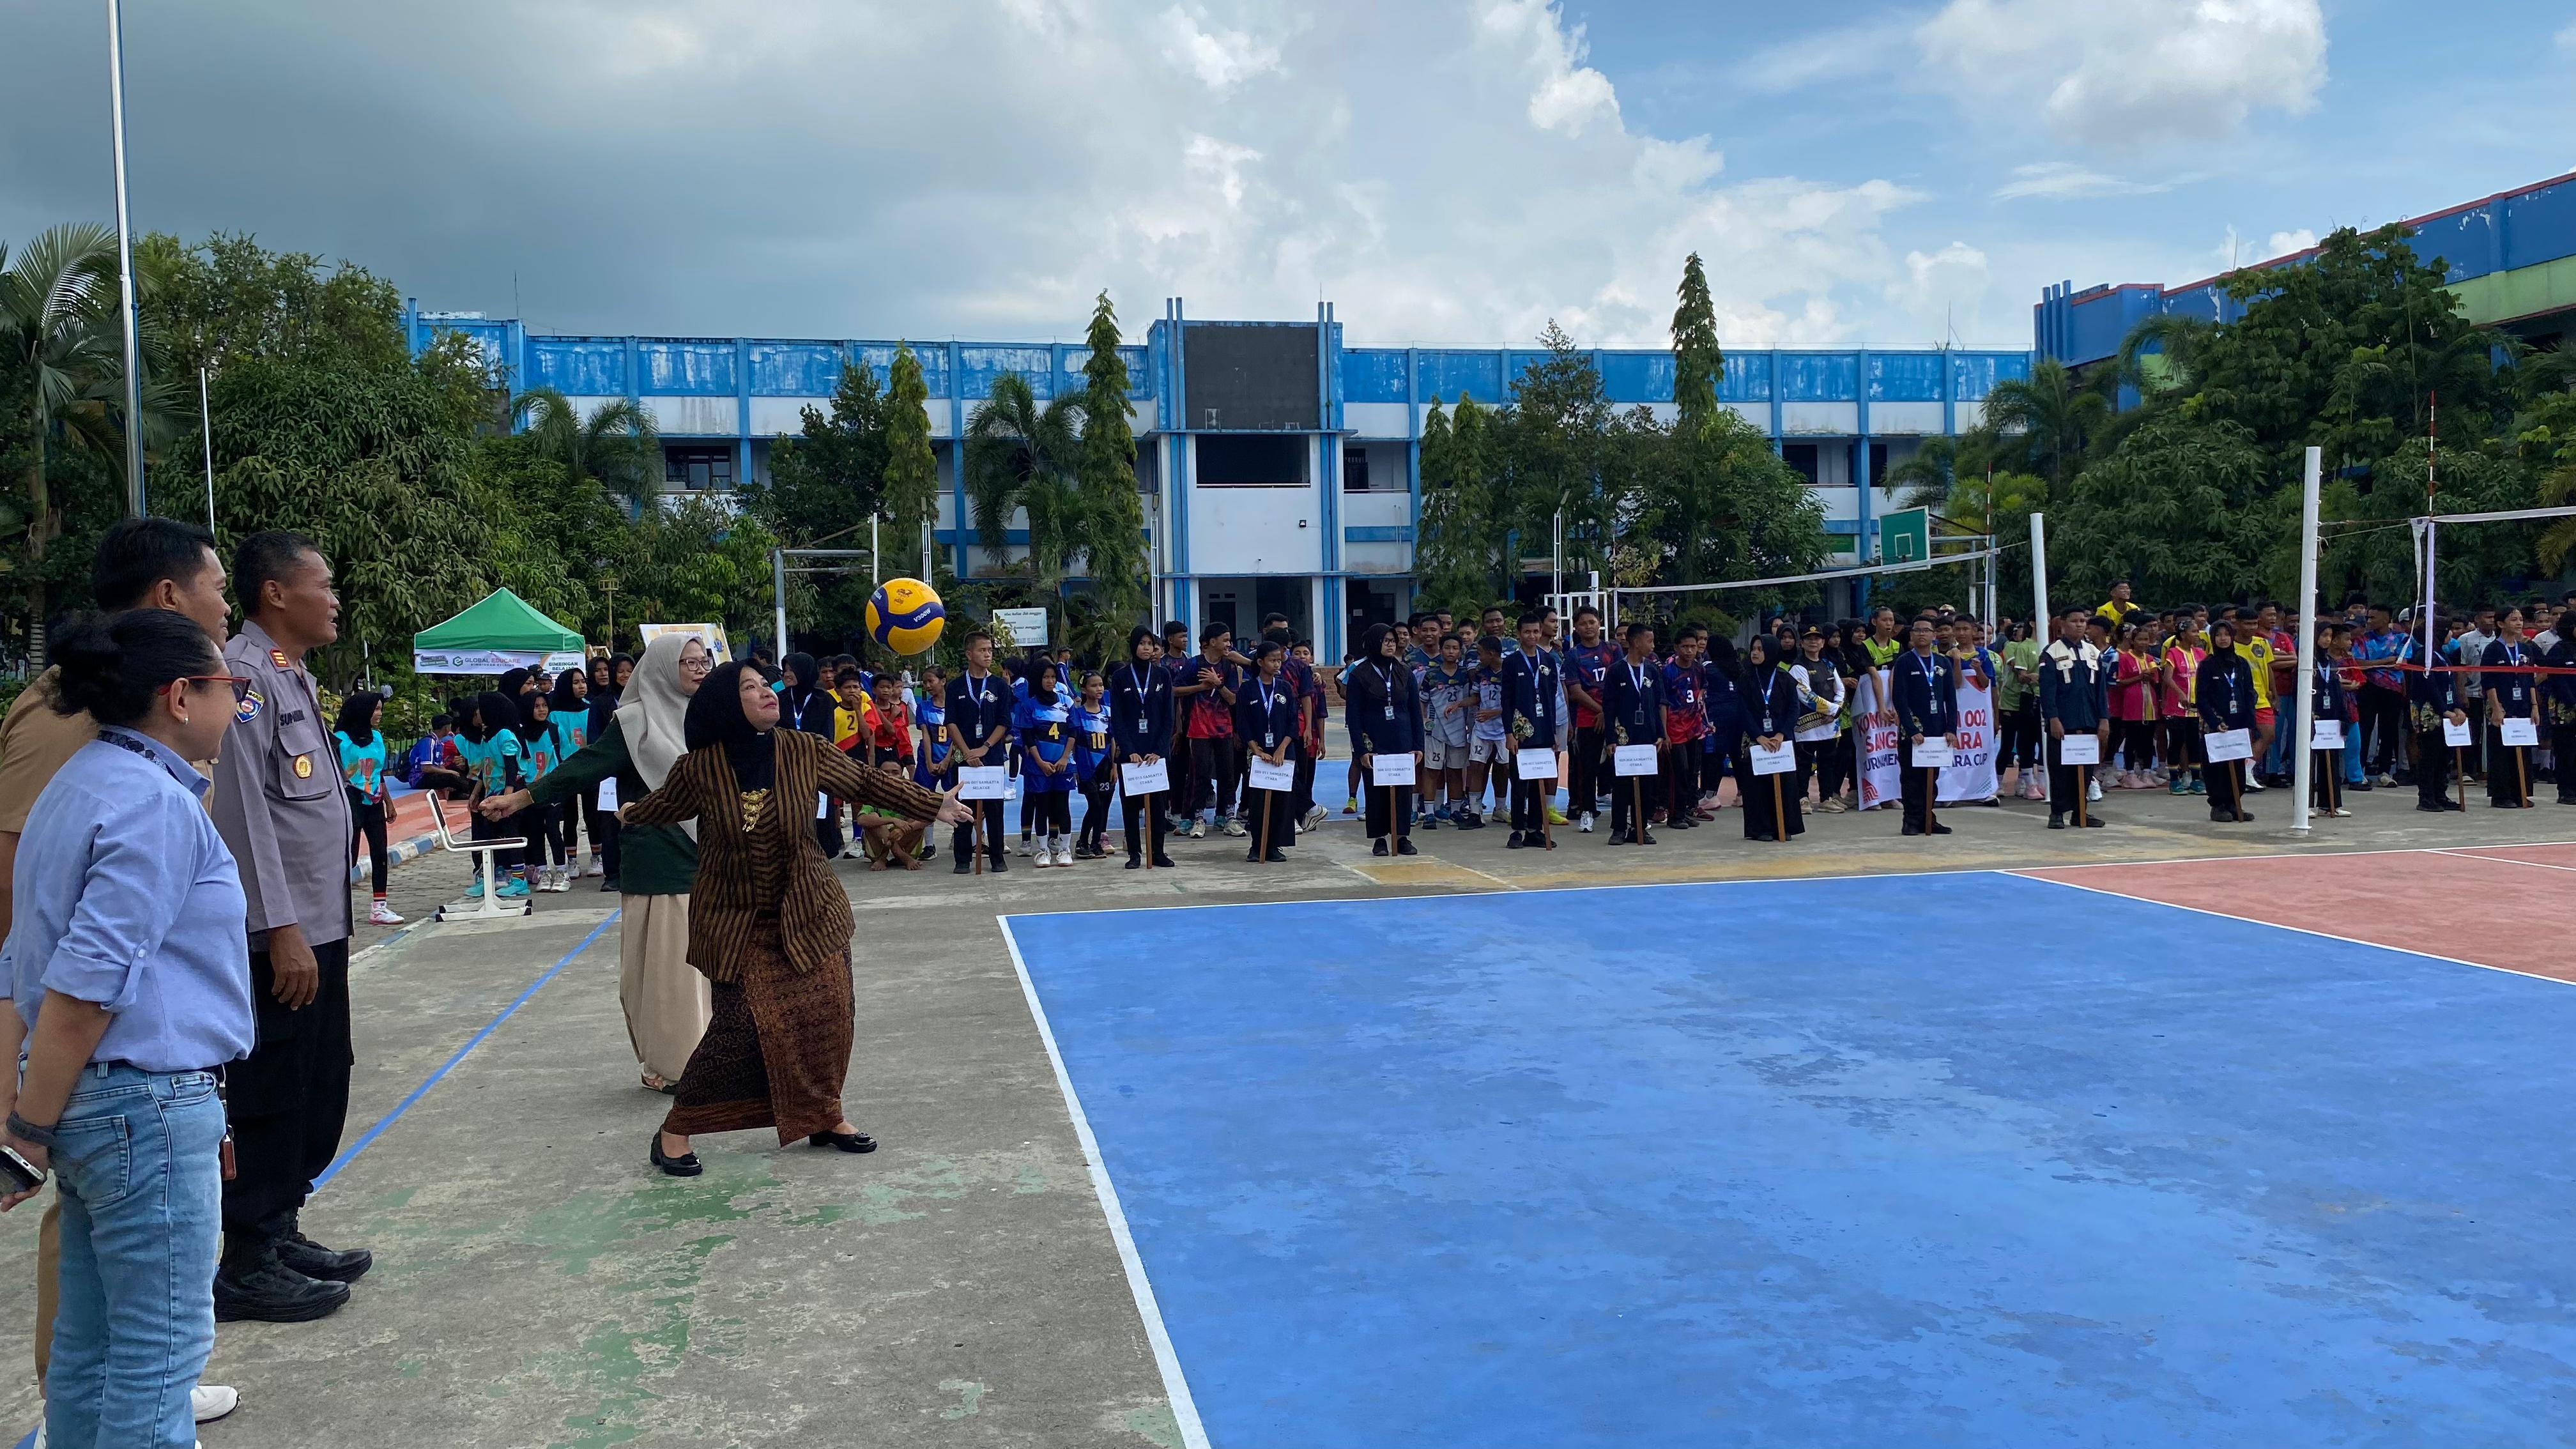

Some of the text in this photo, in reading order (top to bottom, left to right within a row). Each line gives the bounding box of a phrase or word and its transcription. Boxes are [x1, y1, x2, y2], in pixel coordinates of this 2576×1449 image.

[914, 607, 931, 622] V300W
[1593, 667, 1606, 682] 17
[1489, 690, 1497, 701] 12
[1687, 689, 1694, 703] 3
[847, 715, 855, 730] 2
[1965, 709, 1987, 727] 002
[573, 727, 583, 746] 5
[938, 726, 947, 742] 9
[1048, 723, 1059, 740] 4
[1091, 732, 1105, 749] 10
[1866, 731, 1898, 753] SANG
[1432, 753, 1441, 762] 25
[1474, 745, 1483, 755] 12
[535, 751, 545, 770] 9
[1974, 753, 1988, 766] CUP
[1100, 782, 1110, 791] 23
